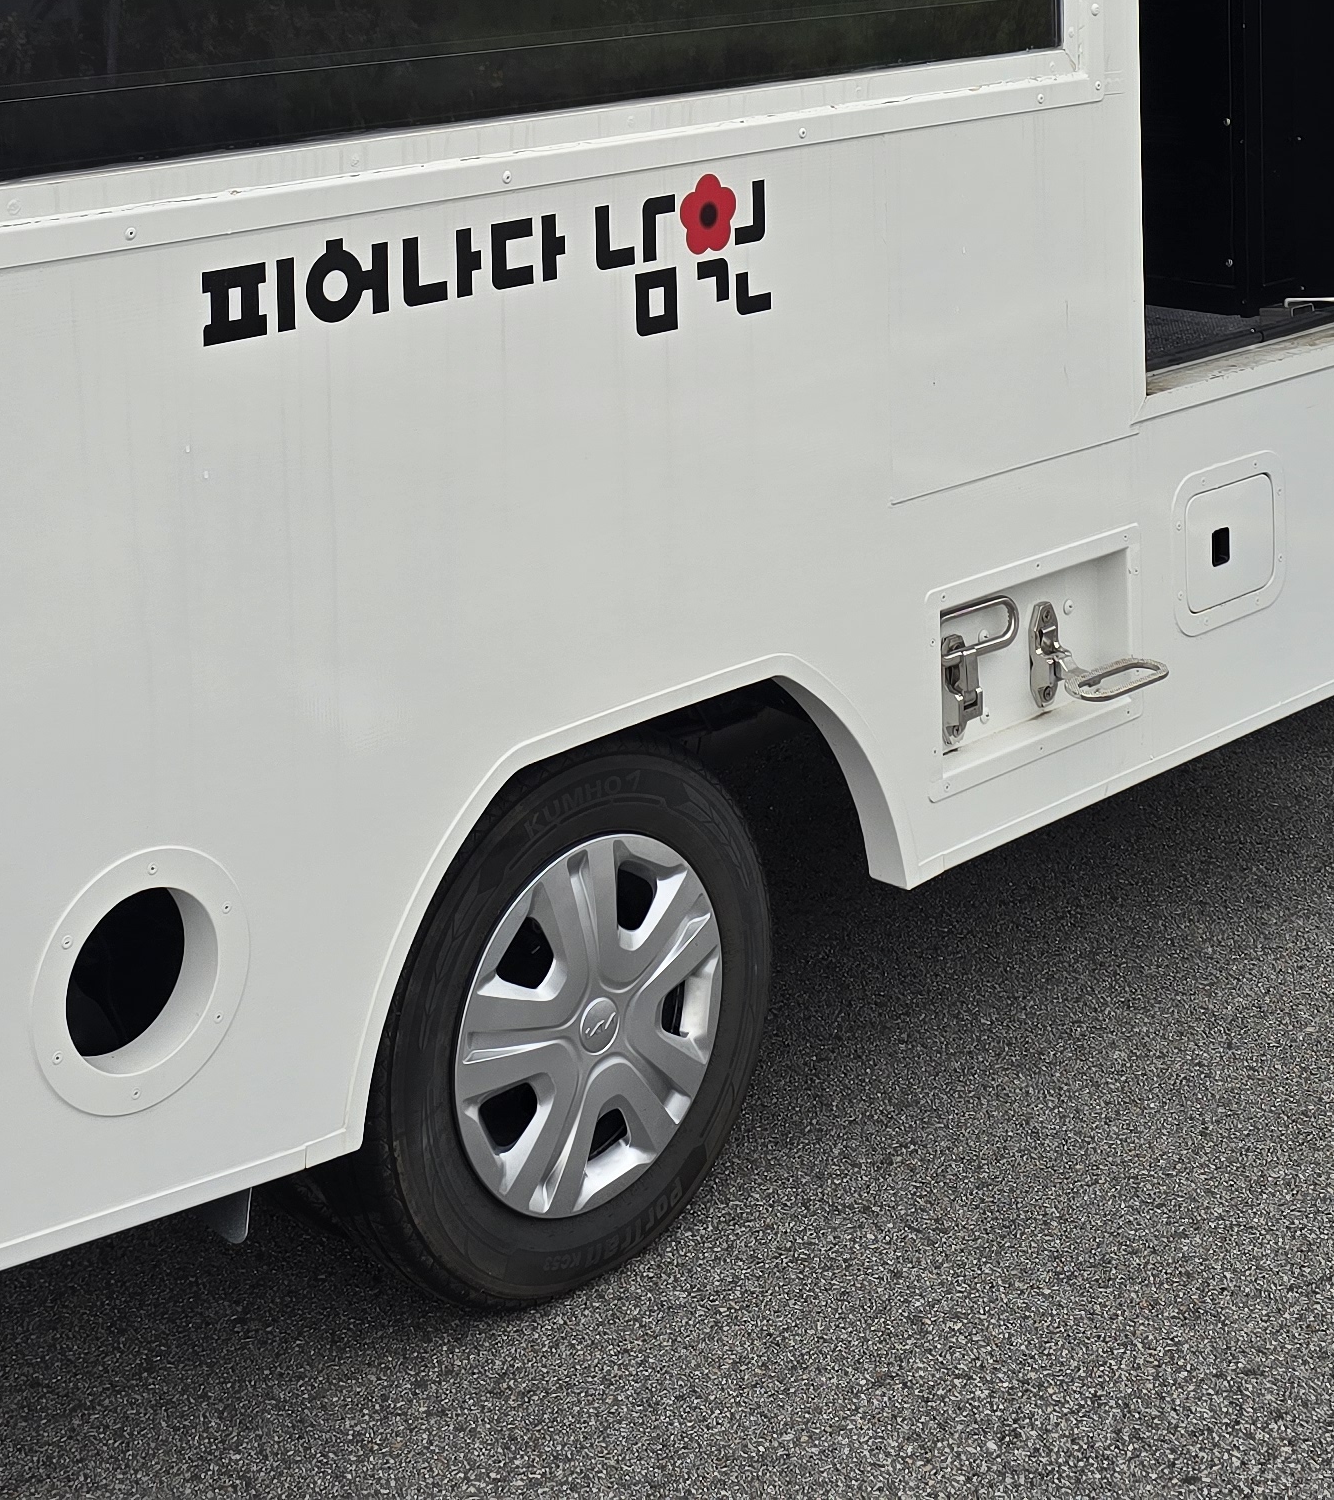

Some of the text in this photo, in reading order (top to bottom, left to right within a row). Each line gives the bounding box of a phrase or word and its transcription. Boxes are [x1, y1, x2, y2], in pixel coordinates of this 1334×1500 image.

[201, 173, 772, 347] 피어나다 남원
[523, 775, 622, 840] KUMHO
